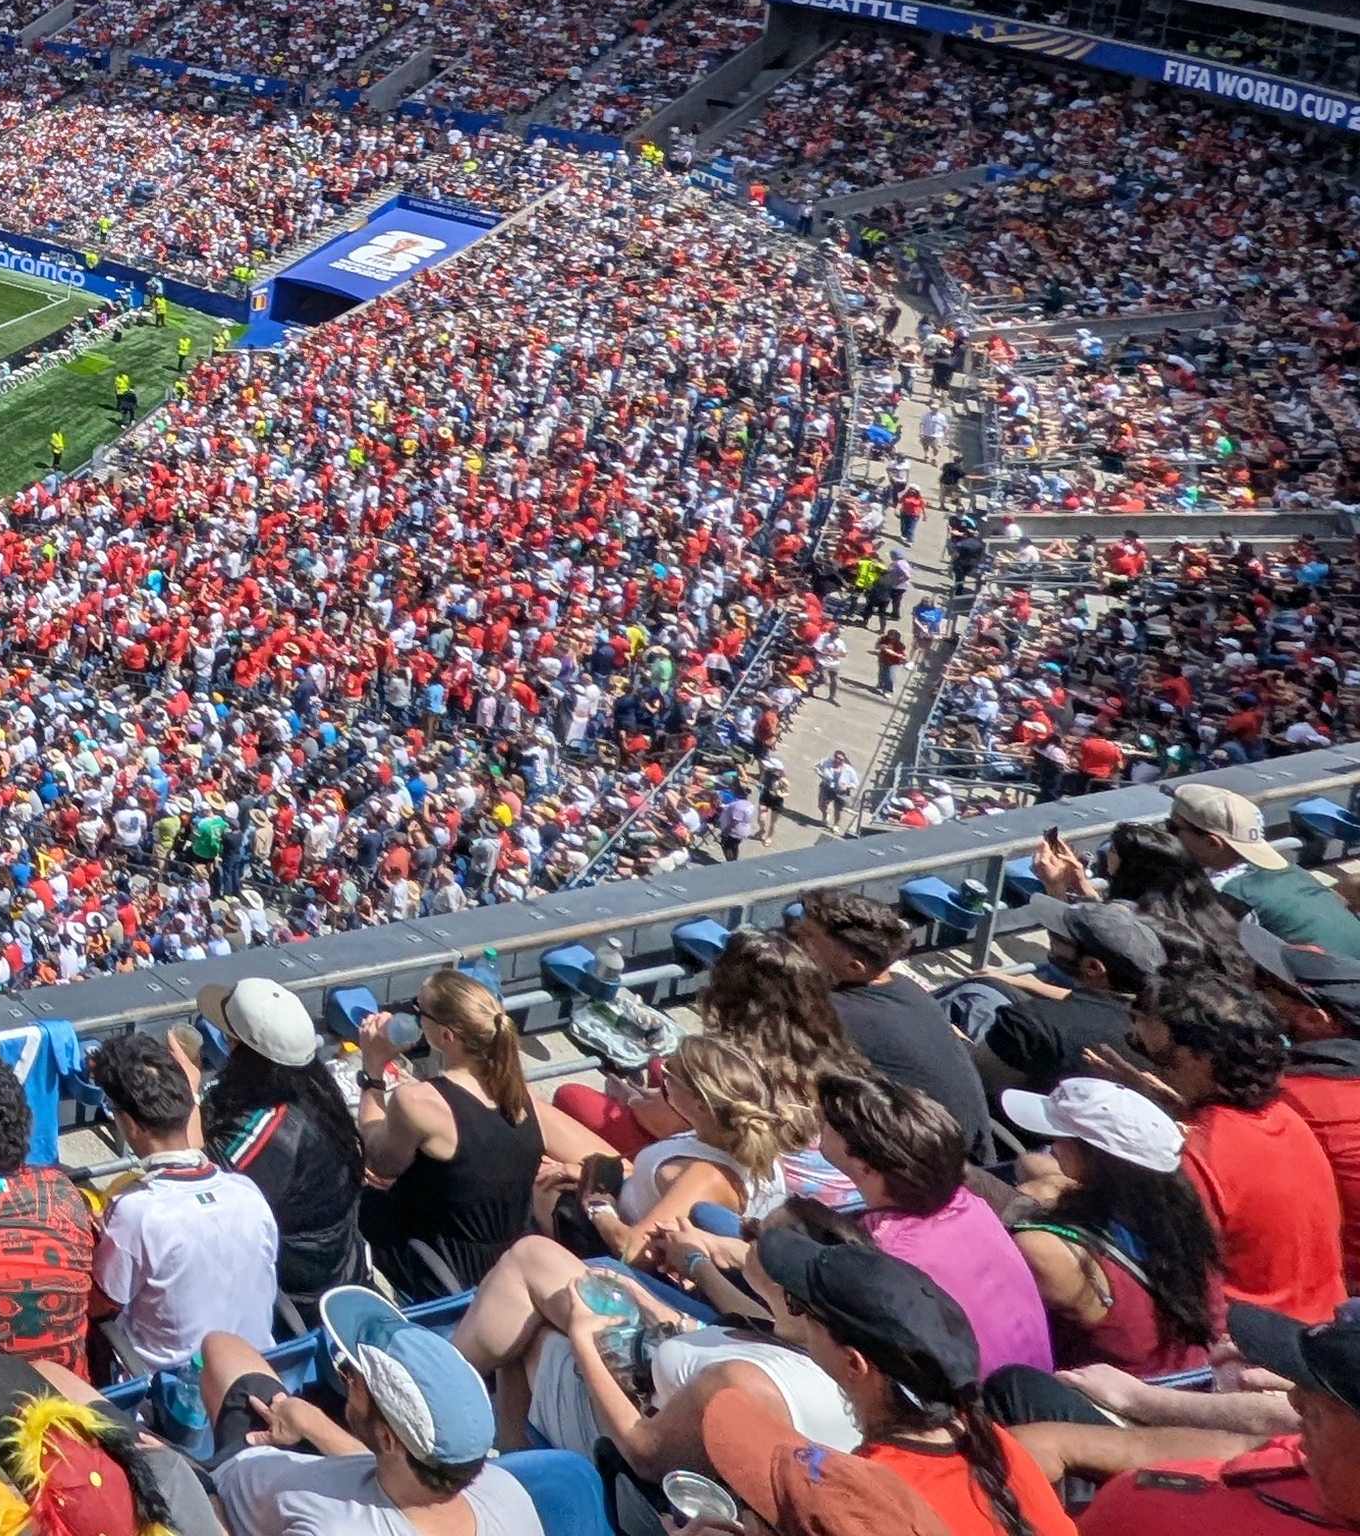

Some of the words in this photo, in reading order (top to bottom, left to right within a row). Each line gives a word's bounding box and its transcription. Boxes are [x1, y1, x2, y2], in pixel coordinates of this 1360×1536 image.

[1163, 60, 1211, 92] FIFA
[1216, 70, 1298, 112] WORLD
[1300, 93, 1347, 125] CUP
